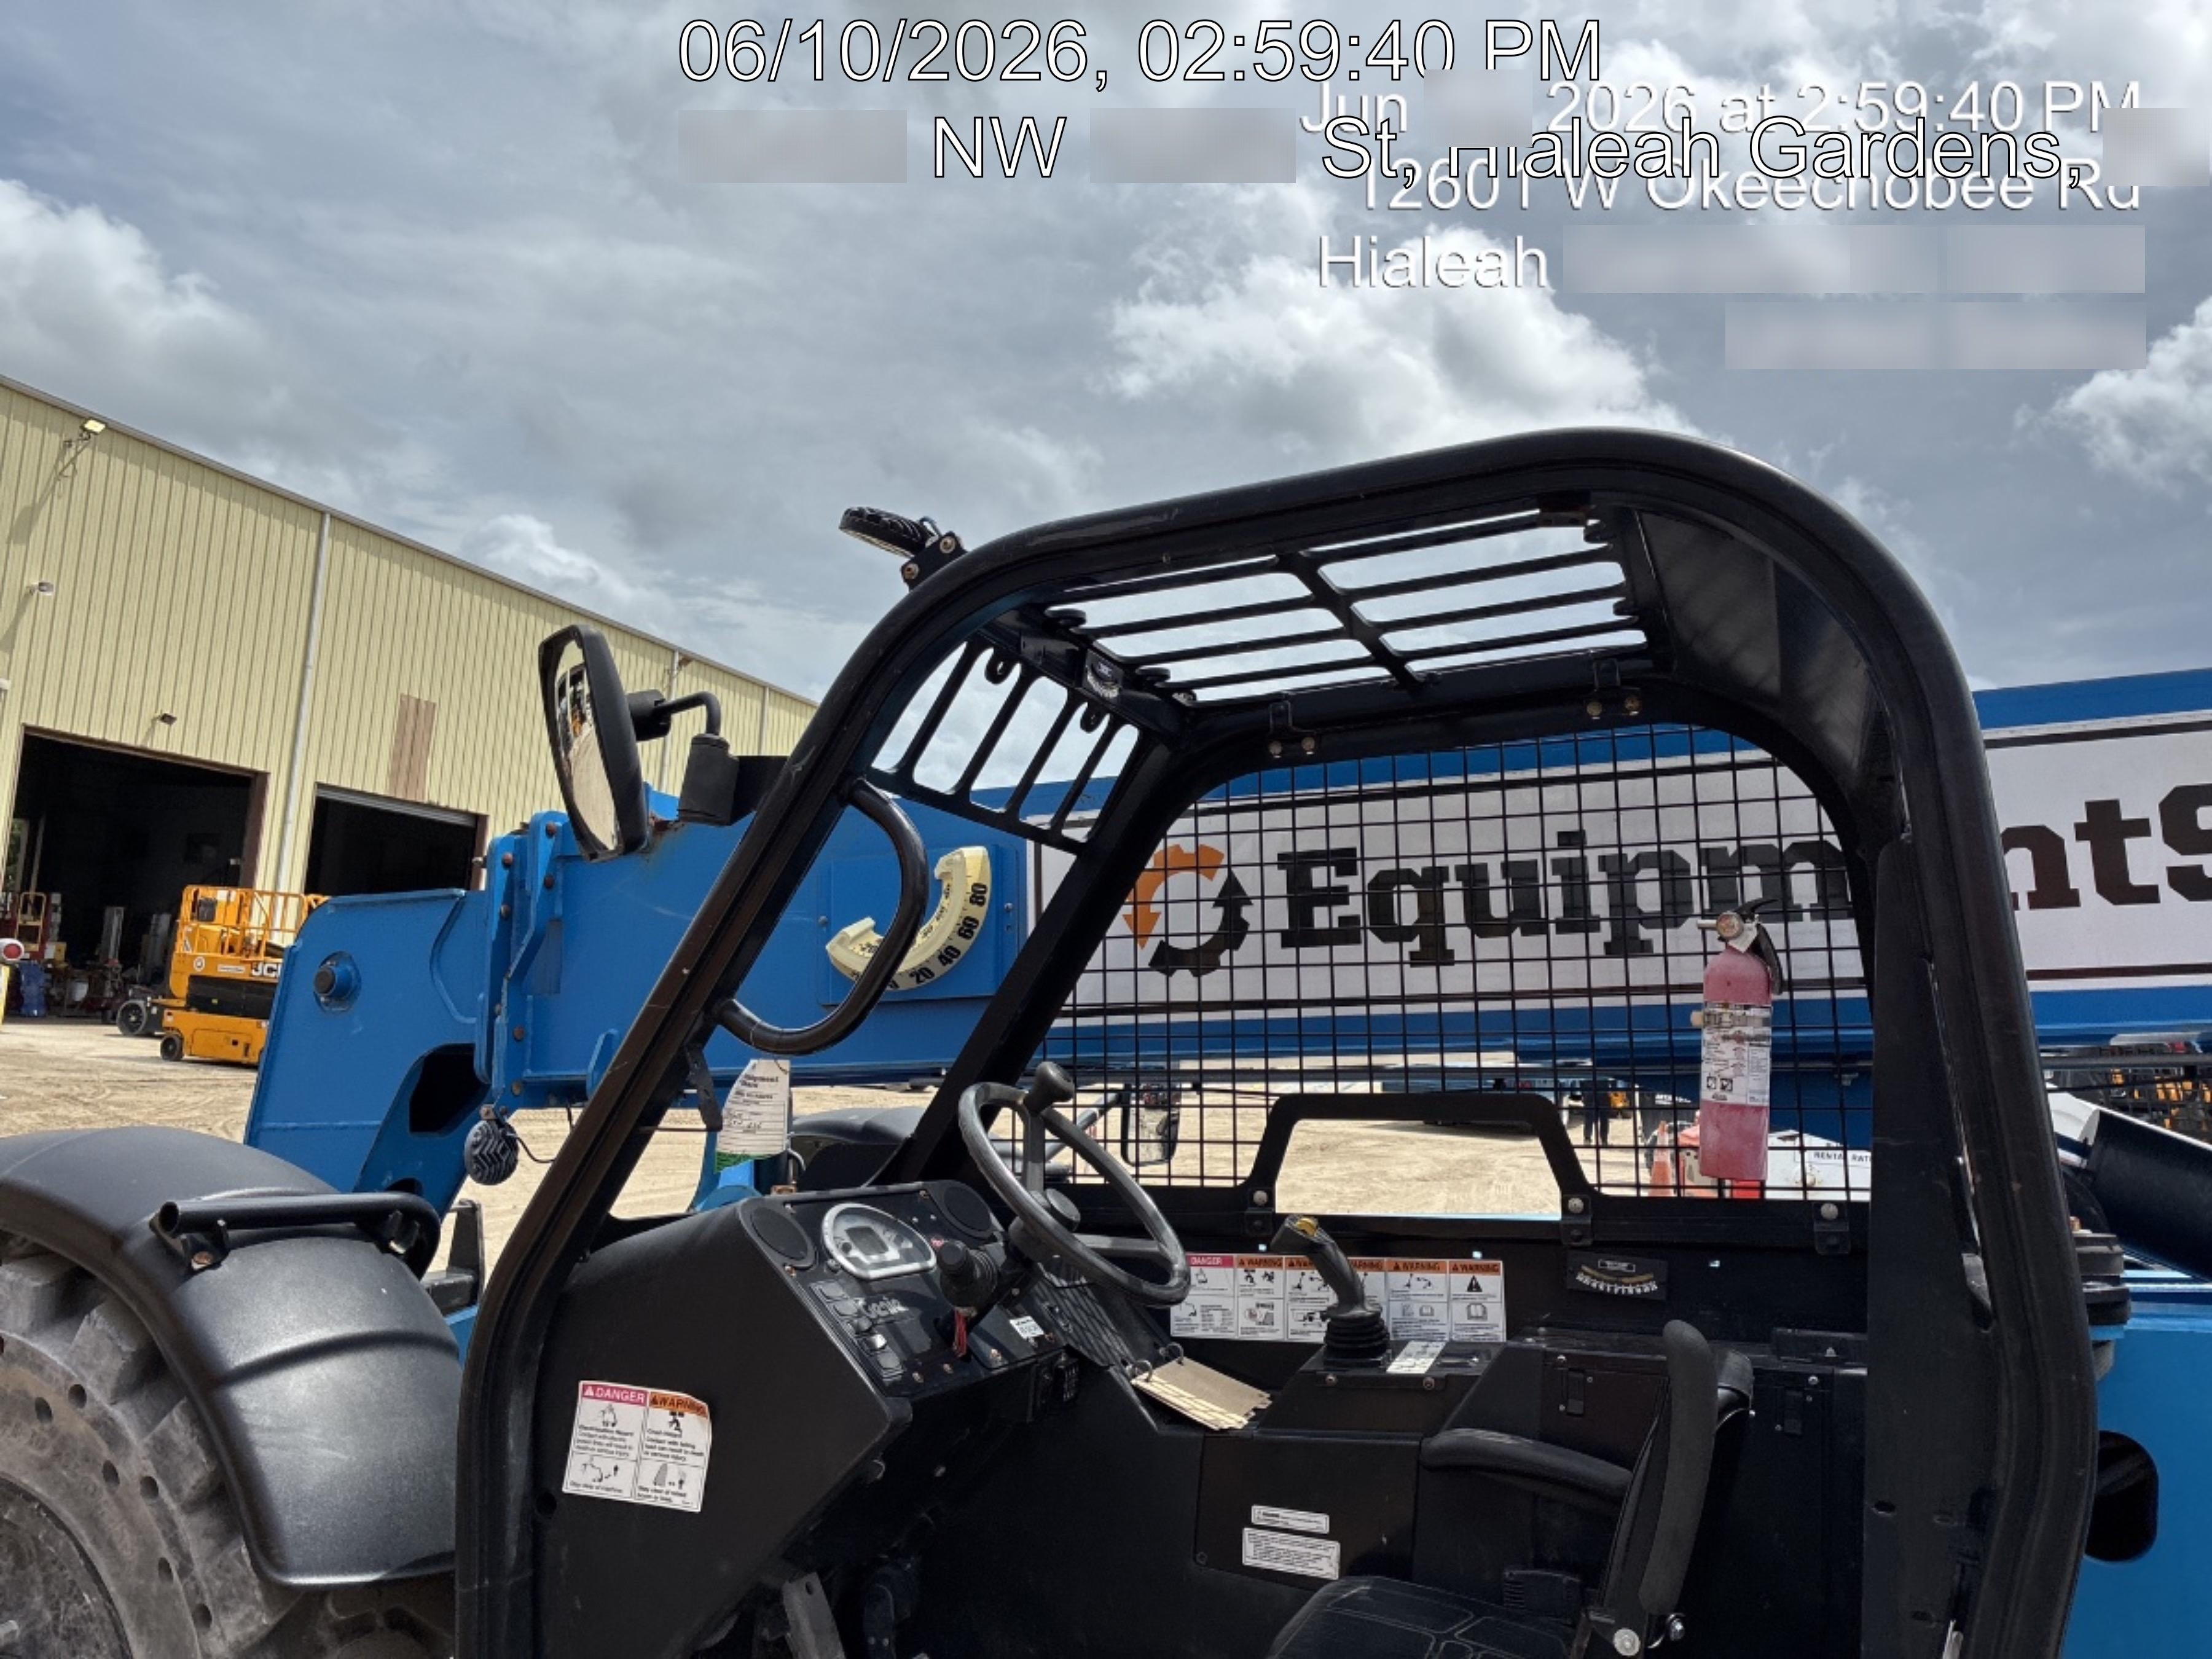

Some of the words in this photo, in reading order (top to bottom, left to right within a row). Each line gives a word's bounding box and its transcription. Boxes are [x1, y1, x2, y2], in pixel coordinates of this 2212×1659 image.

[1277, 783, 2212, 968] EquipmntS
[969, 882, 988, 907] 80
[957, 916, 979, 940] 60
[938, 945, 961, 967] 40
[909, 967, 935, 984] 20
[1813, 1151, 1845, 1160] RENTA
[1190, 1256, 1222, 1265] DANGER
[1247, 1257, 1283, 1268] WARNING
[1351, 1259, 1382, 1270] ARNING
[1402, 1261, 1440, 1271] WARNING
[1459, 1262, 1499, 1273] WARNING
[595, 1387, 645, 1403] DANGER
[659, 1396, 705, 1414] WARNING
